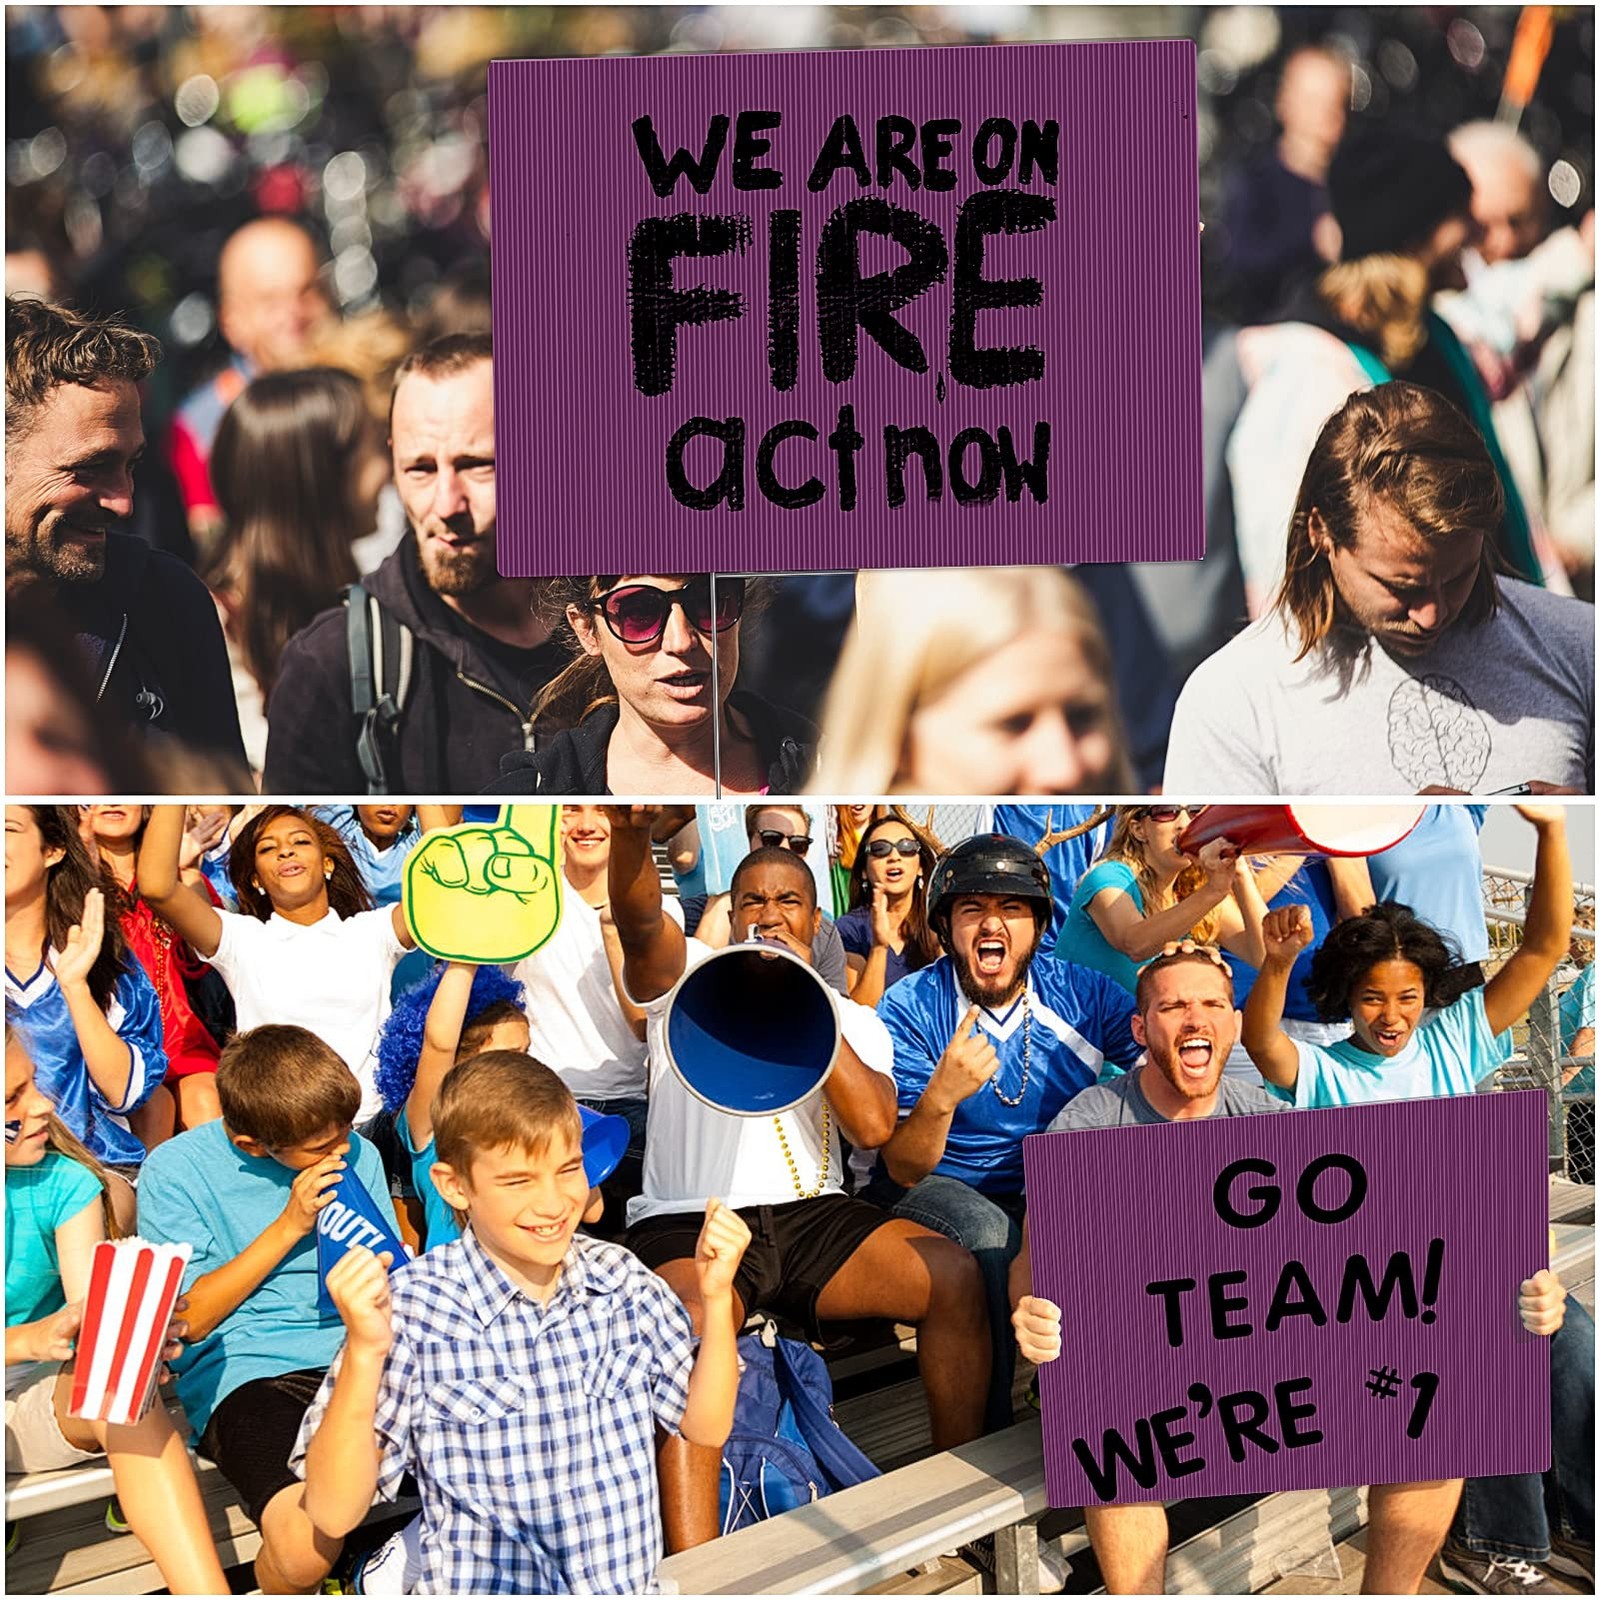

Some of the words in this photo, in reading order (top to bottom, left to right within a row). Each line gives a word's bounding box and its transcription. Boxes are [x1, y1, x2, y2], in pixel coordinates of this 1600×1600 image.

[631, 110, 784, 199] WE
[806, 114, 962, 193] ARE
[972, 117, 1060, 187] ON
[626, 188, 1058, 397] FIRE
[665, 403, 865, 513] act
[1213, 1153, 1368, 1229] GO
[1145, 1237, 1445, 1348] TEAM!
[1071, 1376, 1324, 1502] WE'RE
[1365, 1365, 1440, 1440] #1
